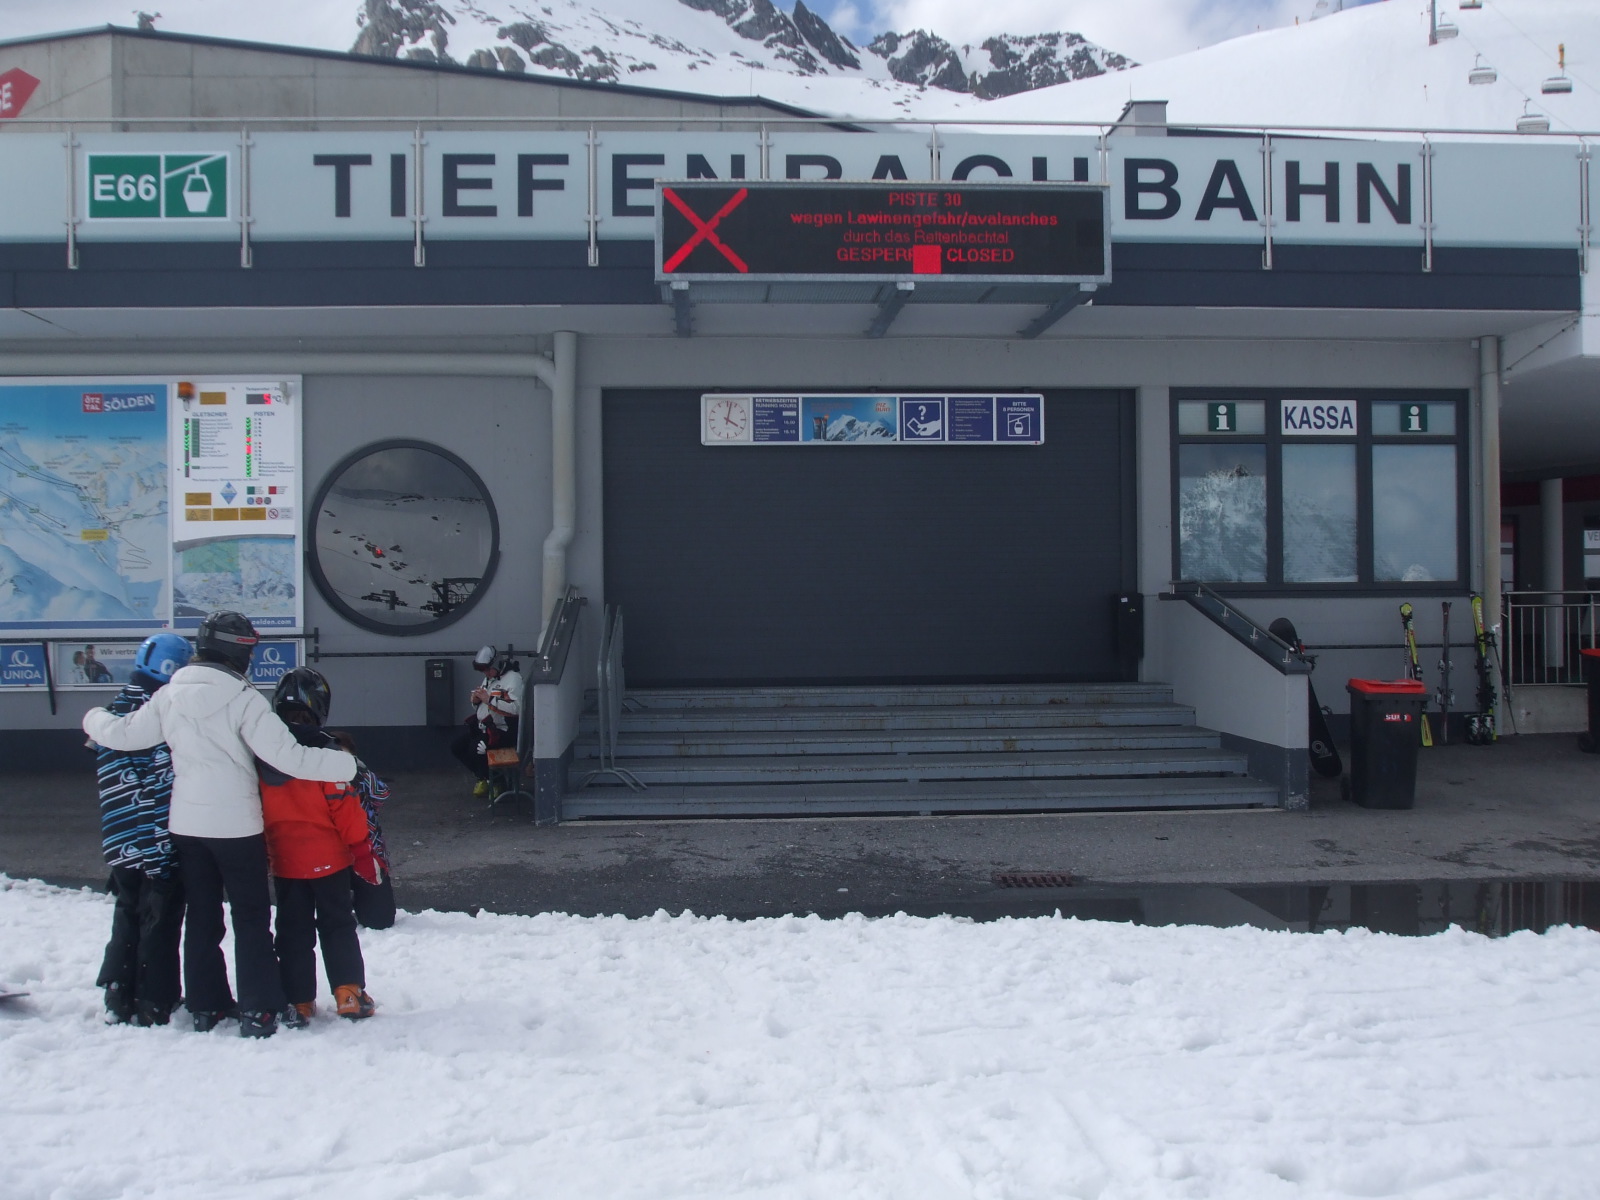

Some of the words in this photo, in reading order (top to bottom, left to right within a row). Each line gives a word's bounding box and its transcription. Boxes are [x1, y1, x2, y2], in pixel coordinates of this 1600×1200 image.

[93, 173, 158, 202] E66
[888, 191, 939, 207] PISTE
[944, 192, 962, 207] 30
[790, 212, 843, 228] wegen
[843, 229, 881, 244] durch
[884, 229, 911, 244] das
[946, 247, 1015, 263] CLOSED
[104, 394, 155, 412] SÖLDEN
[1284, 405, 1354, 430] KASSA
[3, 669, 42, 680] UNIQA
[254, 666, 287, 677] UNIQ
